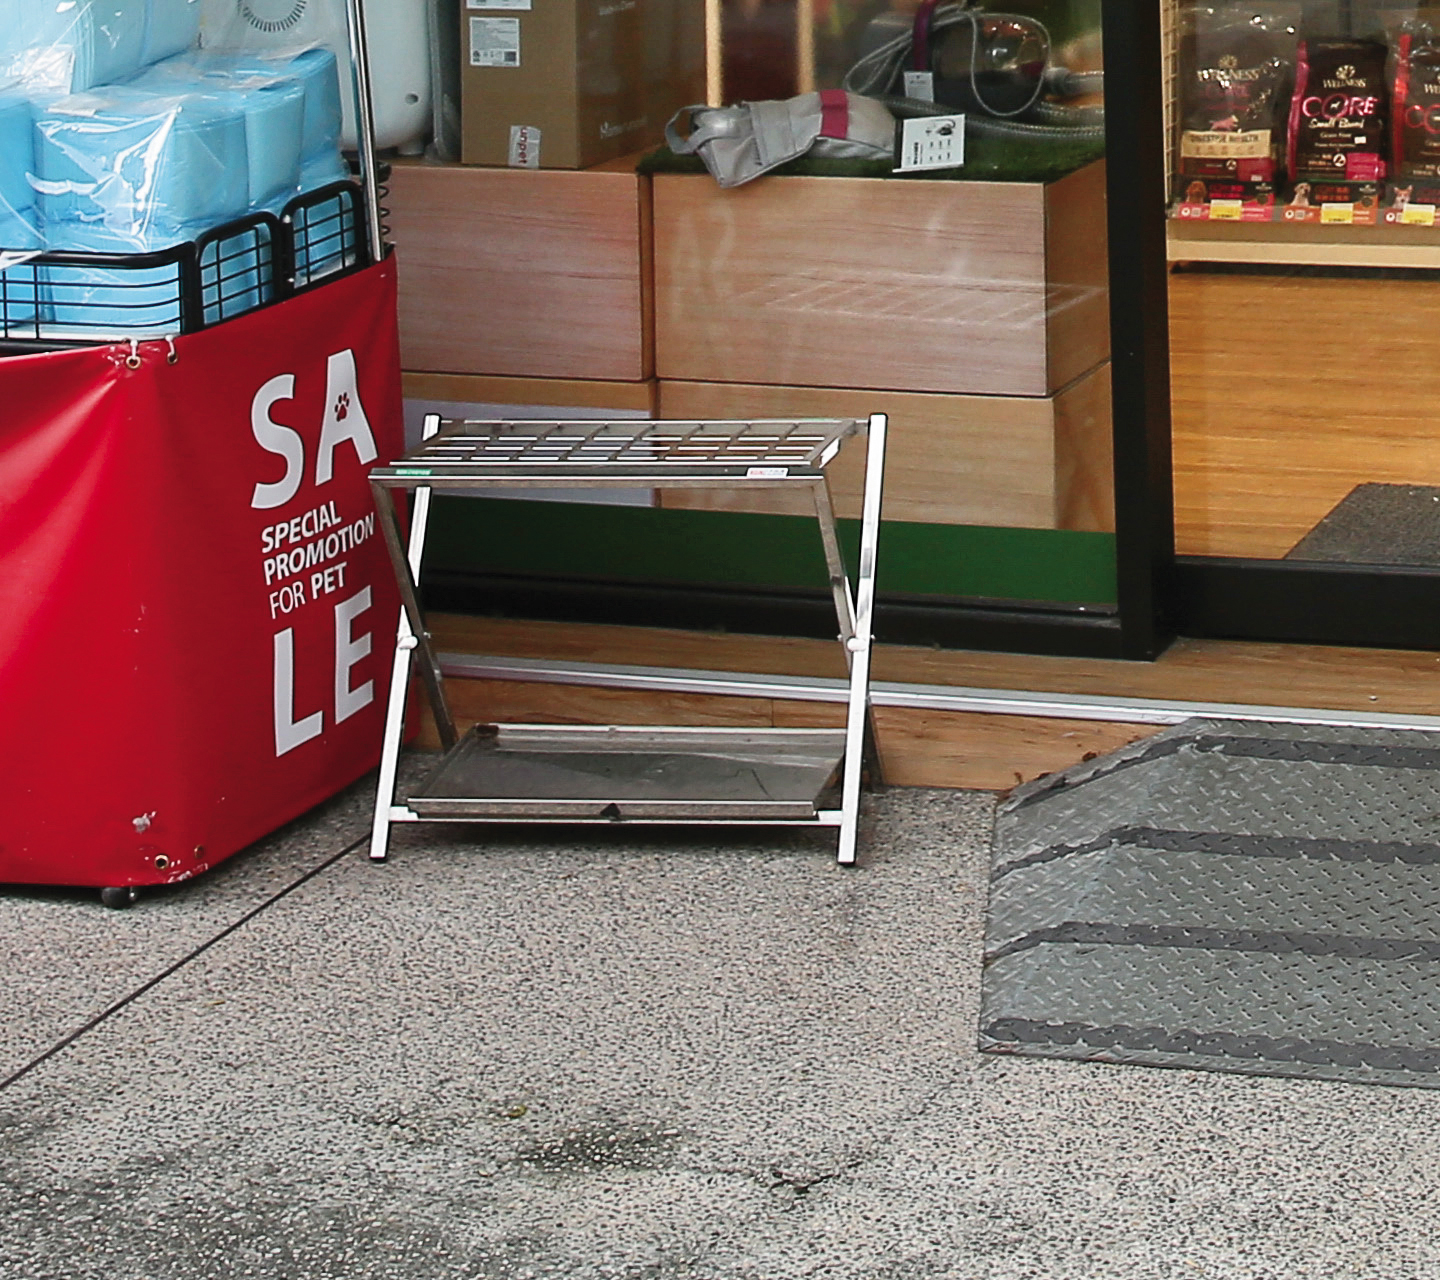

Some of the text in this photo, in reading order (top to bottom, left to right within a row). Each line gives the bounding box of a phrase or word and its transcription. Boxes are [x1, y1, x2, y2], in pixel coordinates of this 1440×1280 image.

[1301, 95, 1378, 120] CORE
[1322, 76, 1367, 89] WELLNESS
[248, 347, 378, 511] SA
[258, 501, 342, 555] SPECIAL
[261, 512, 375, 587] PROMOTION
[268, 559, 349, 621] FOR PET
[271, 584, 375, 759] LE
